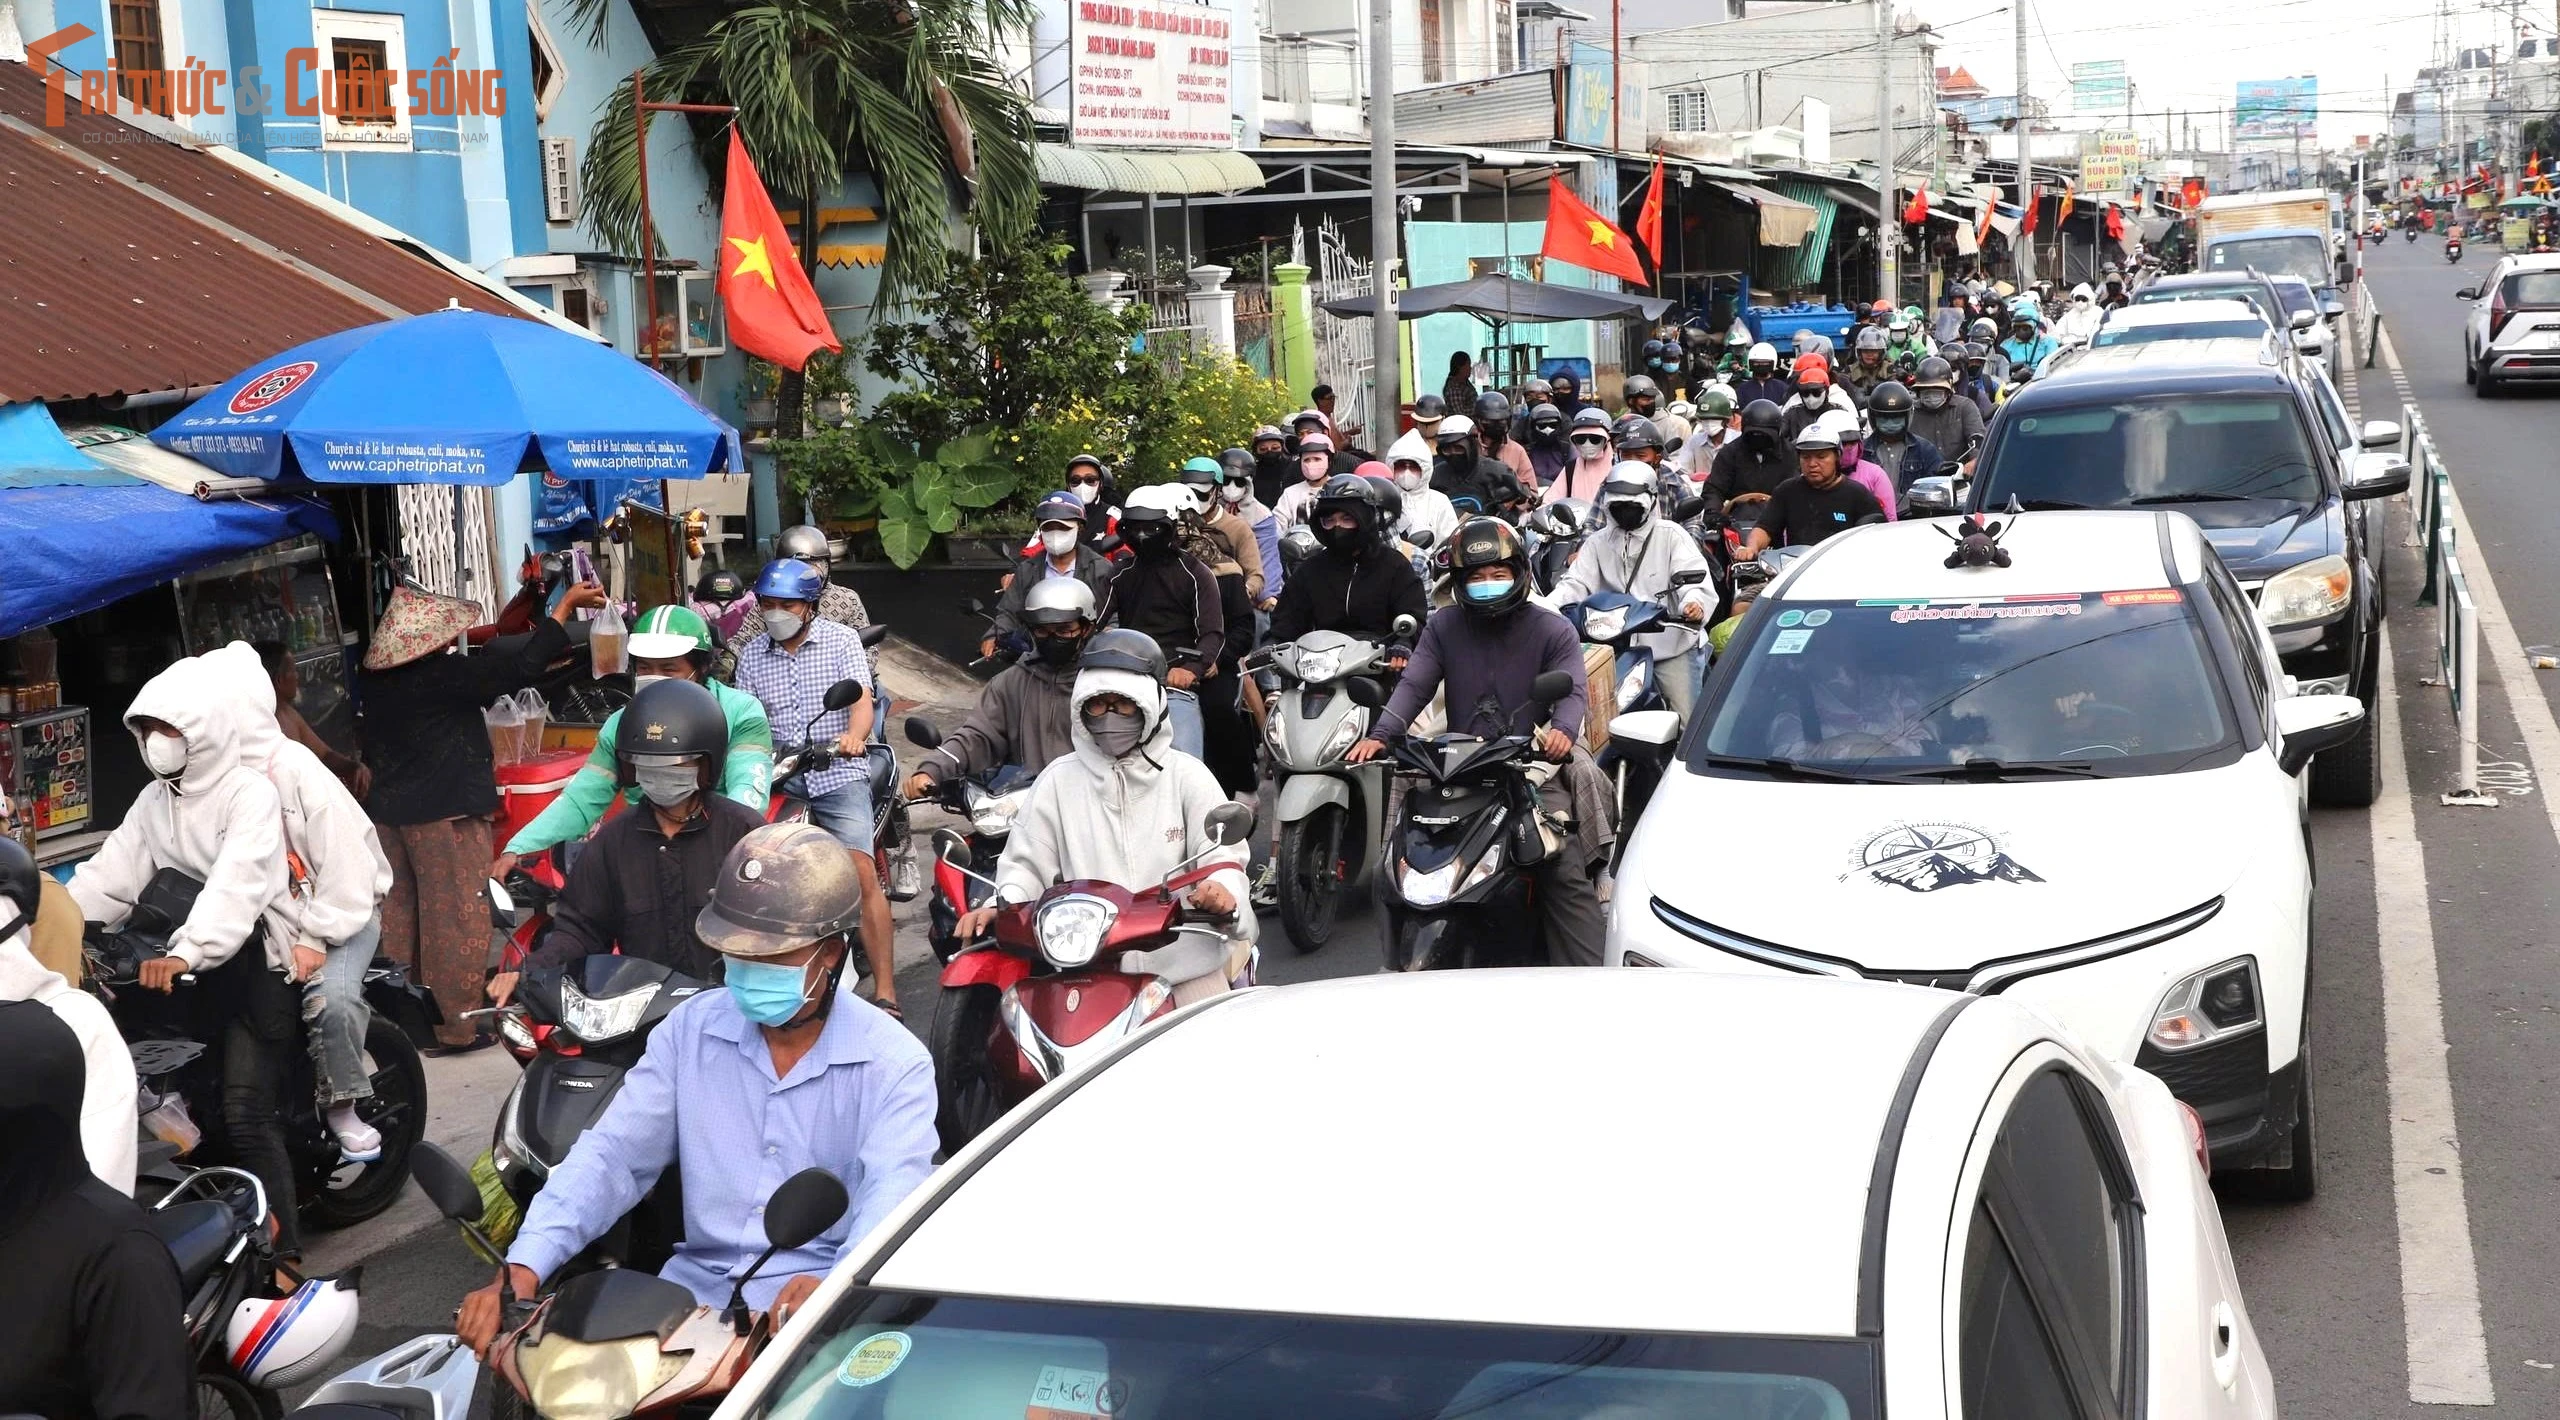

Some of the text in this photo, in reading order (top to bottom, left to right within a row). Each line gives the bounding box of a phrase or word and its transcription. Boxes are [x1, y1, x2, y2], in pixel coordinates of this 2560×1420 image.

[1584, 68, 1609, 127] Tiger
[324, 441, 354, 458] Chuyên
[363, 441, 371, 455] &
[381, 442, 394, 458] hạt
[396, 443, 426, 458] robusta,
[427, 443, 444, 458] culi,
[446, 443, 468, 459] moka,
[568, 439, 590, 455] Chuyên
[597, 440, 602, 453] &
[610, 440, 620, 455] hạt
[621, 440, 644, 454] robusta,
[658, 440, 675, 455] moka,
[327, 457, 485, 475] www.caphetriphat.vn
[572, 455, 689, 471] www.caphetriphat.vn
[1438, 747, 1458, 755] YAMAHA
[1490, 806, 1508, 827] YAMAHA
